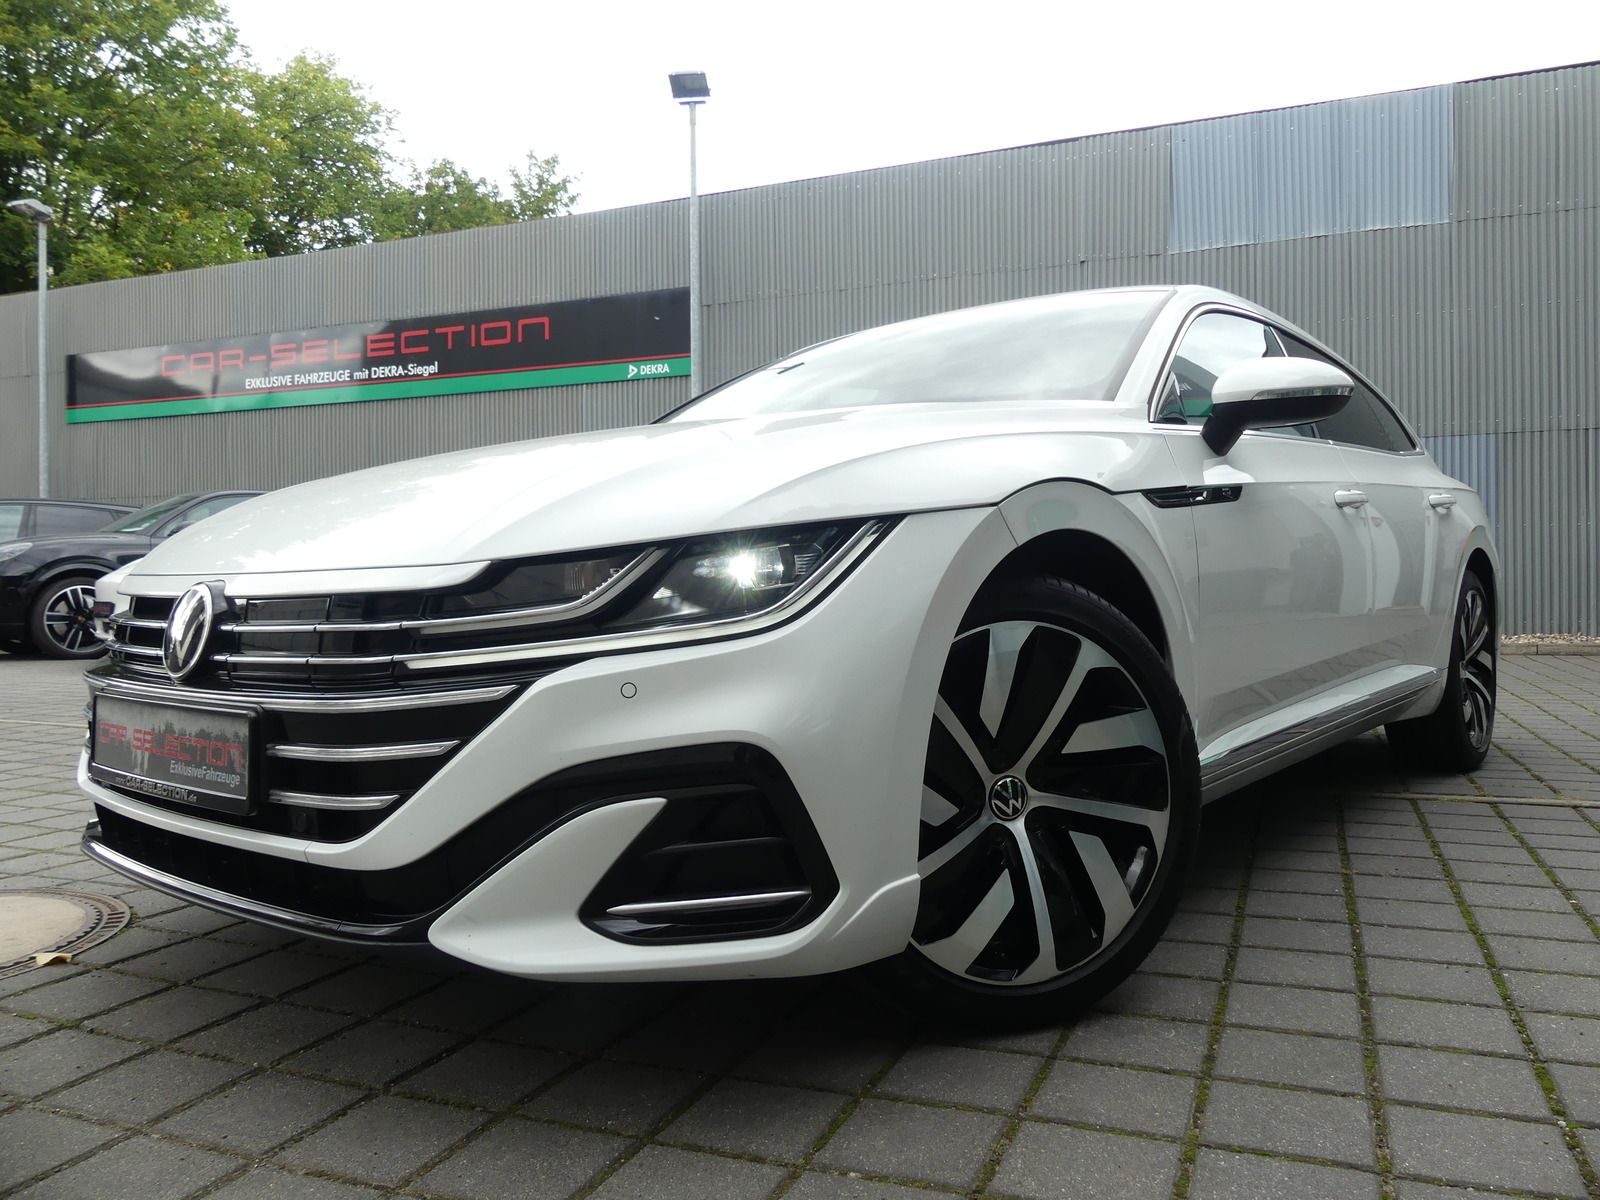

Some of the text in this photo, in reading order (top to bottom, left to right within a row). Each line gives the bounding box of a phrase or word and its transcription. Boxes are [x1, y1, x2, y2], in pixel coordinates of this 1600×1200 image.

[159, 315, 551, 379] CAR-SELECTION
[245, 361, 439, 390] EXKLUSIVE FAHRZEUGE mit DEKRA-Siegel
[640, 362, 670, 375] DEKRA
[169, 759, 241, 788] ExklusiveFahrzeuge
